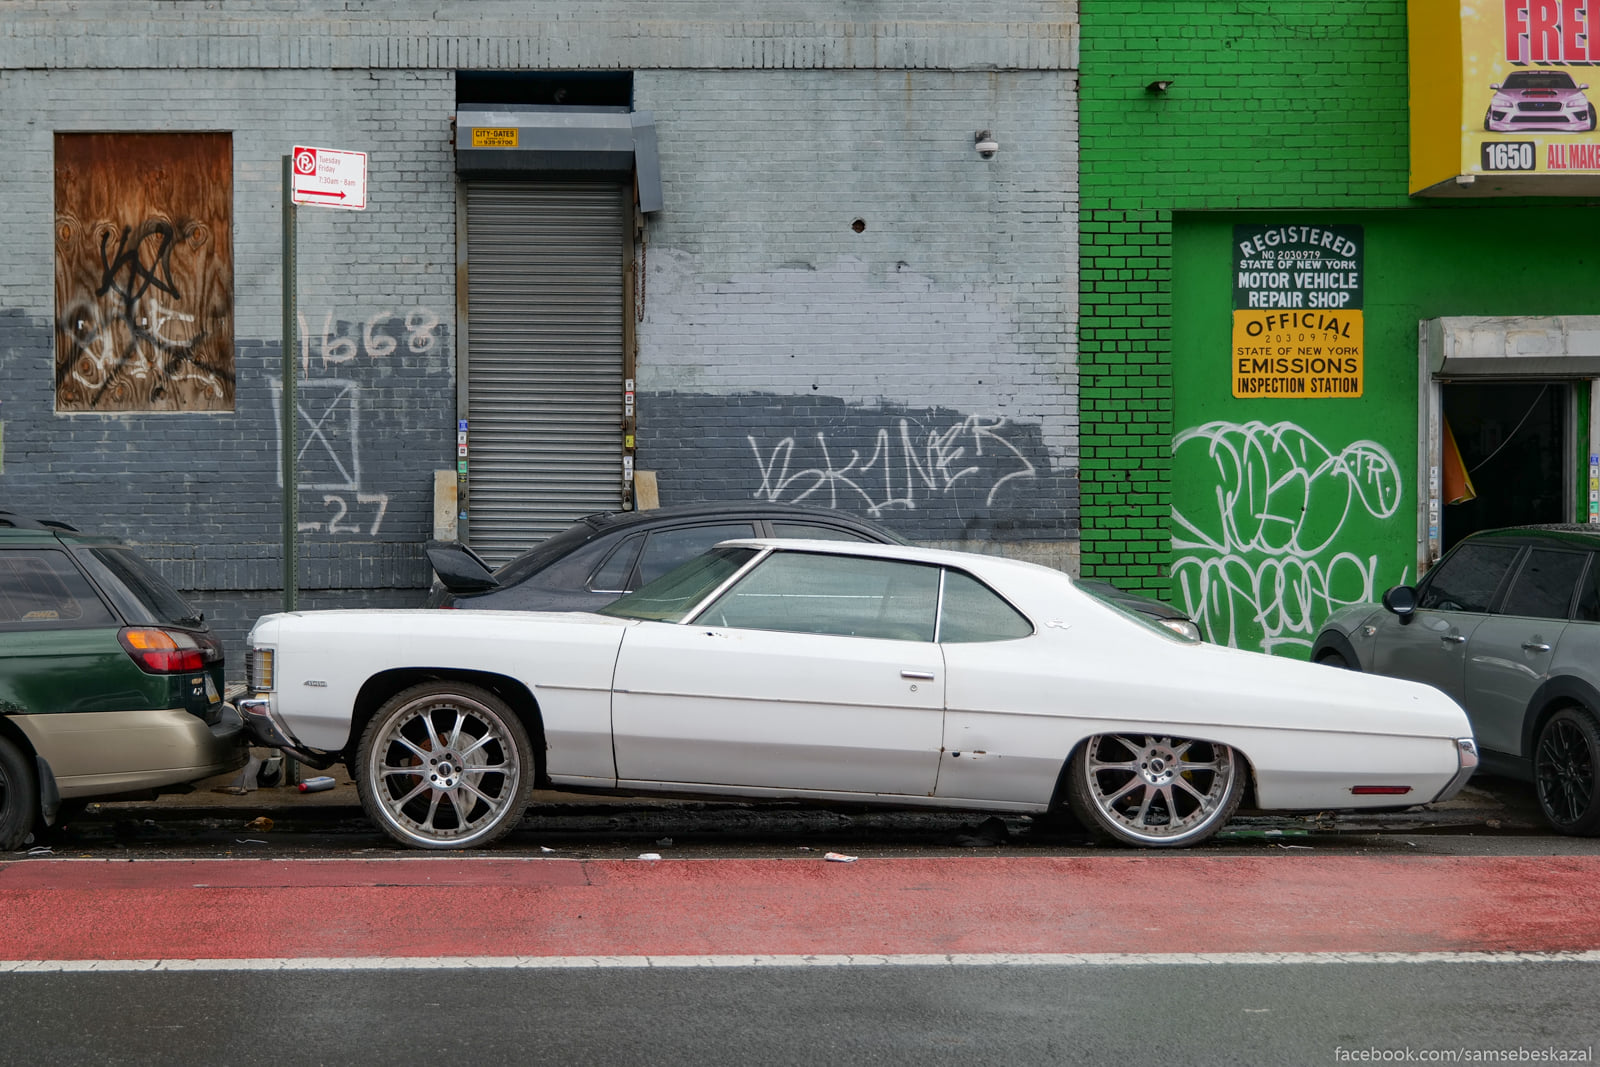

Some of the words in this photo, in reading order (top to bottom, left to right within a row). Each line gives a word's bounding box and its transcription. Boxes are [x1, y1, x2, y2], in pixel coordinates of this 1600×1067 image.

[319, 155, 341, 165] Tuesday
[1486, 143, 1532, 170] 1650
[1547, 144, 1567, 169] ALL
[318, 165, 336, 174] Friday
[319, 176, 339, 185] 7:30am
[343, 178, 356, 186] 8am
[1239, 226, 1356, 258] REGISTERED
[1277, 250, 1321, 260] 2030979
[1239, 260, 1274, 269] STATE
[1278, 260, 1293, 269] OF
[1296, 260, 1322, 269] NEW
[1325, 260, 1356, 269] YORK
[1238, 272, 1289, 289] MOTOR
[1294, 272, 1358, 289] VEHICLE
[1248, 291, 1302, 308] REPAIR
[1308, 291, 1350, 308] SHOP
[1246, 312, 1351, 338] OFFICIAL
[297, 307, 440, 376] 1668
[1237, 347, 1272, 356] STATE
[1277, 347, 1293, 356] OF
[1297, 347, 1322, 356] NEW
[1327, 347, 1359, 356] YORK
[1238, 358, 1357, 374] EMISSIONS
[1238, 377, 1305, 393] INSPECTION
[1310, 377, 1358, 393] STATION
